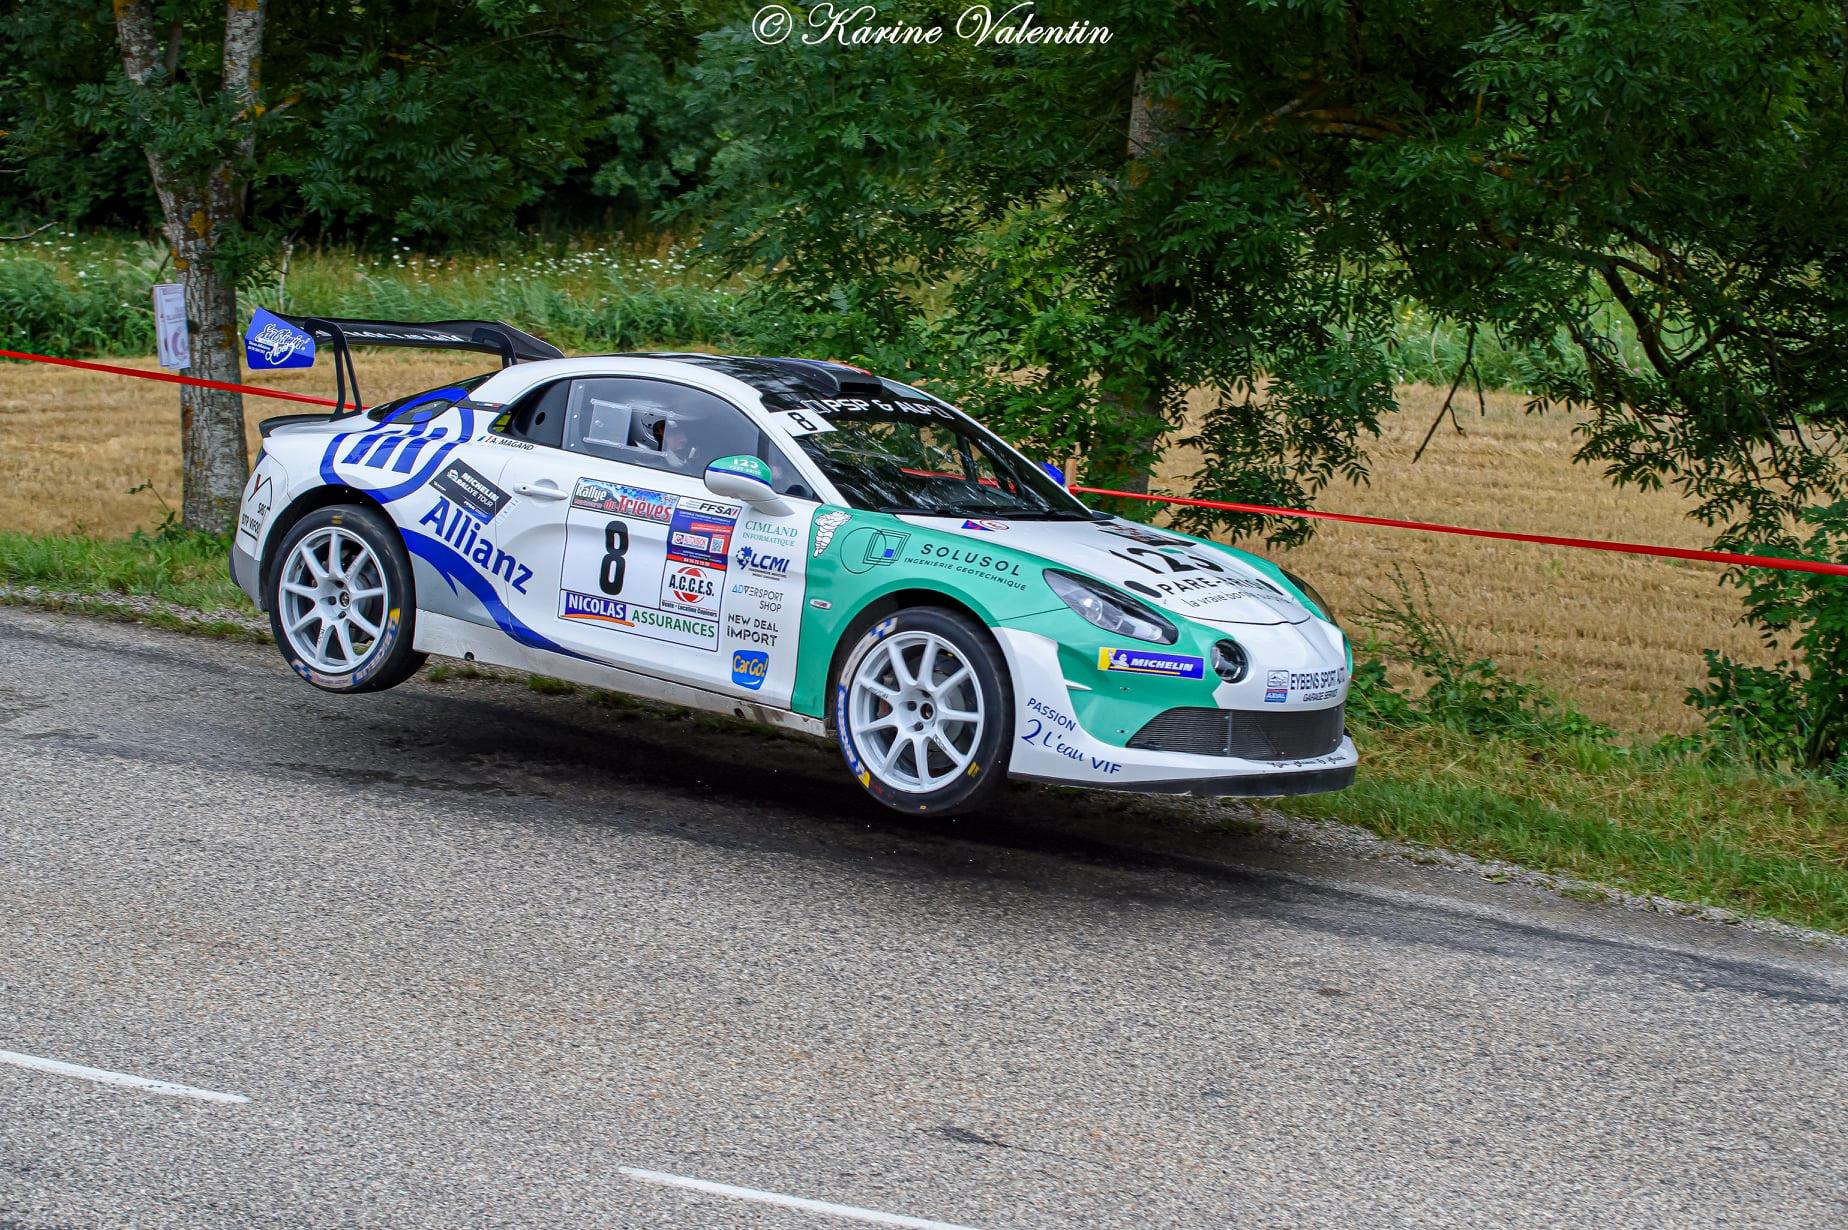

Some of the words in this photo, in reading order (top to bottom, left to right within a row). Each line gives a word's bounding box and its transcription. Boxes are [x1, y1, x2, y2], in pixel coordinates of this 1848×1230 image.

[787, 411, 818, 431] 8
[499, 438, 535, 451] MAGAND
[455, 478, 480, 498] RALLYE
[477, 493, 495, 508] TOUR
[460, 472, 500, 502] MICHELIN
[576, 484, 607, 502] Rallye
[699, 502, 733, 516] FFSA
[742, 531, 796, 547] INFORMATIQUE
[745, 520, 798, 538] CIMLAND
[418, 496, 534, 596] Allianz
[599, 520, 629, 596] 8
[750, 553, 790, 573] LCMI
[920, 543, 1020, 576] SOLUSOL
[904, 557, 954, 570] INGENIERIE
[956, 565, 1027, 591] GEOTECHNIQUE
[669, 573, 715, 597] A.C.C.E.S.
[568, 593, 625, 620] NICOLAS
[632, 609, 715, 638] ASSURANCES
[759, 600, 782, 613] SHOP
[728, 613, 751, 626] NEW
[754, 618, 778, 632] DEAL
[727, 625, 778, 647] IMPORT
[1130, 658, 1194, 672] MICHELIN
[1290, 672, 1320, 690] EYBENS
[1026, 697, 1077, 731] PASSION
[1021, 718, 1042, 746] 2
[1091, 757, 1122, 774] VIF
